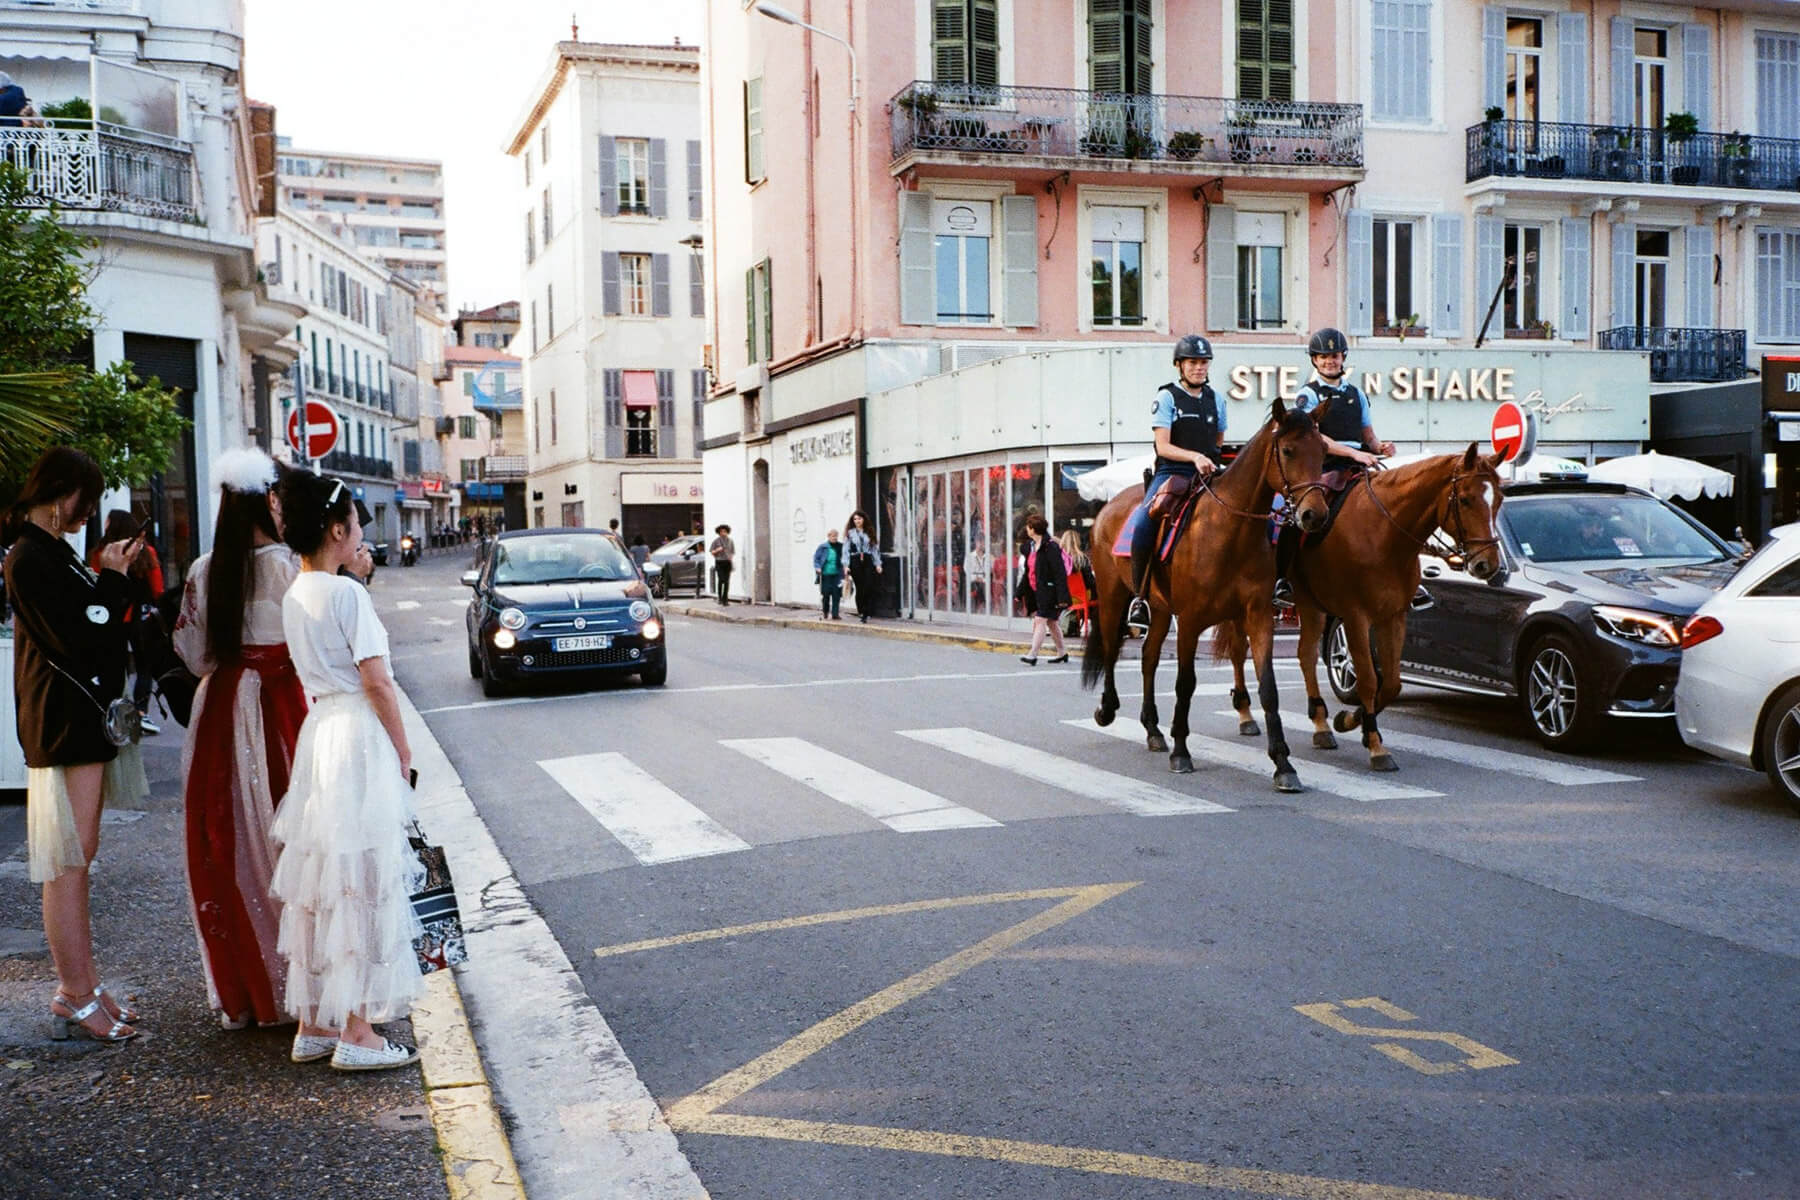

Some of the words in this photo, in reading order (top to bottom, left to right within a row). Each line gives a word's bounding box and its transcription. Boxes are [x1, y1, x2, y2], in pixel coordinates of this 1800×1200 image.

[1230, 365, 1353, 401] STE
[1364, 372, 1381, 395] N
[1391, 366, 1516, 401] SHAKE
